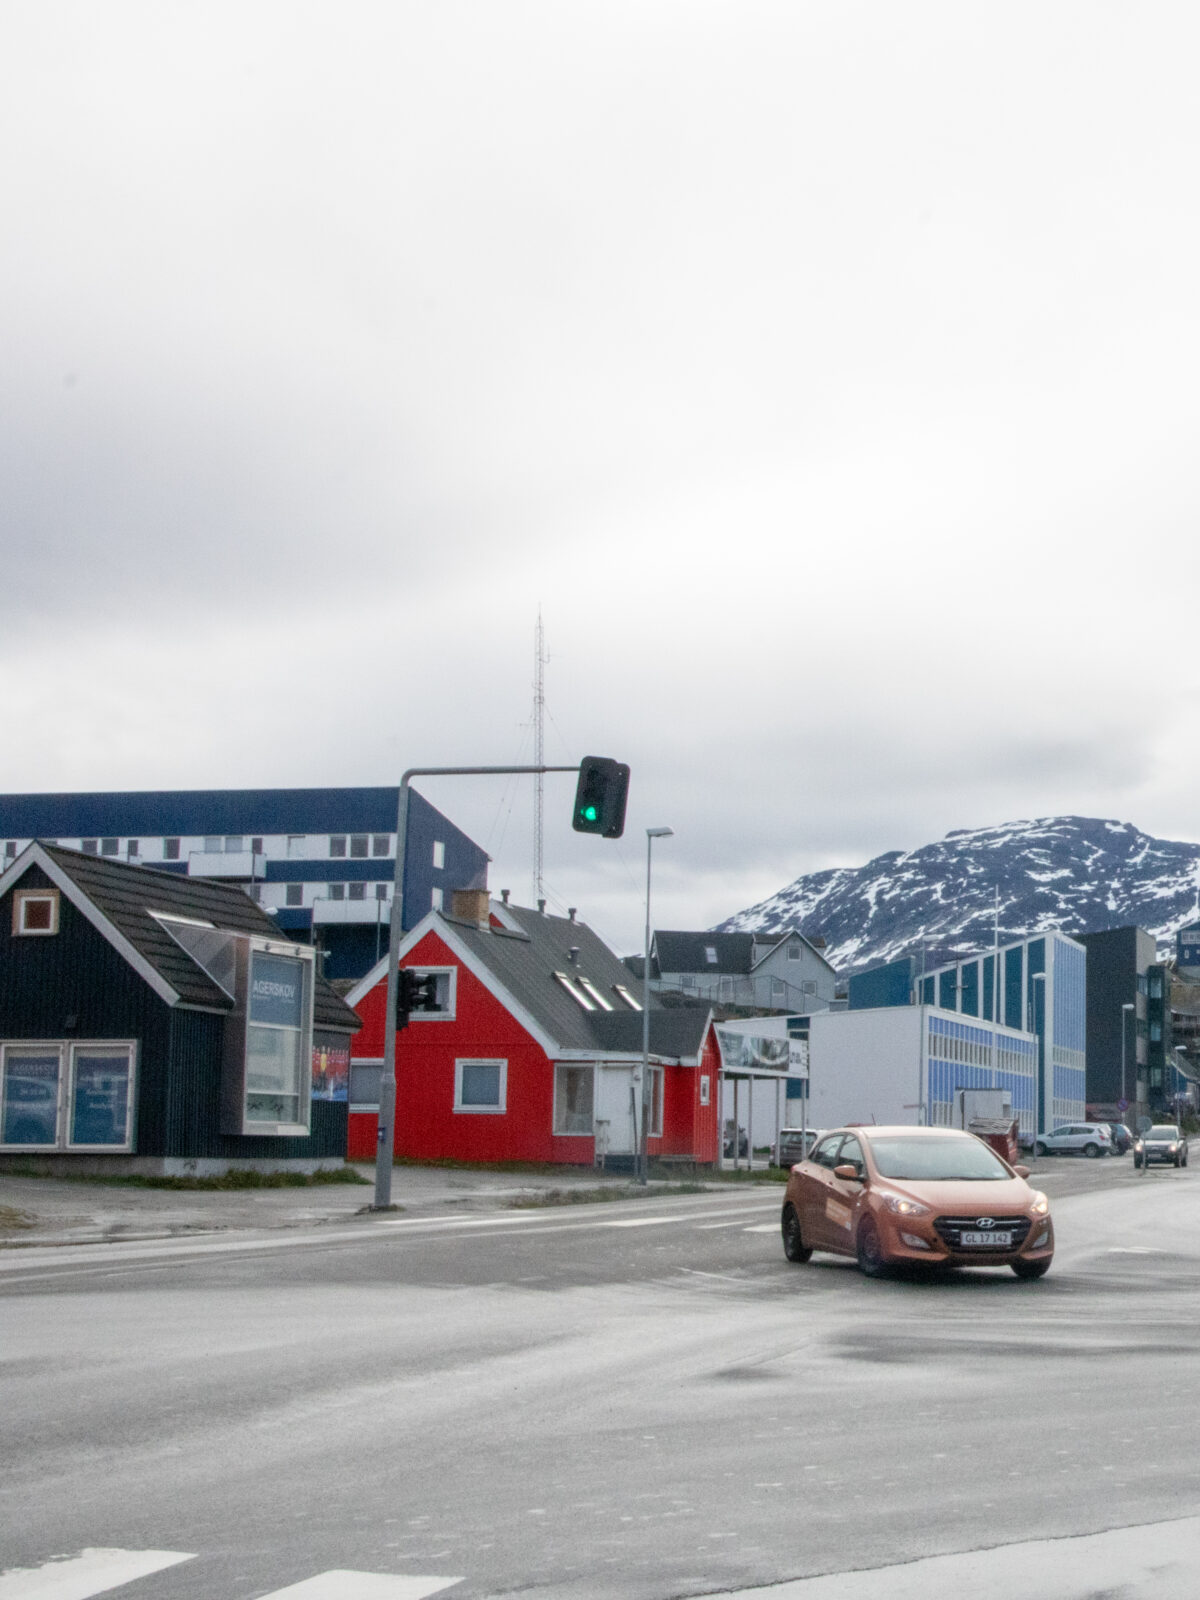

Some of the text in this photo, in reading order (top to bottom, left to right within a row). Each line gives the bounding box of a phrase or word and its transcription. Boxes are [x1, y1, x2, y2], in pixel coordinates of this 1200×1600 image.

[252, 979, 296, 999] AGERSKOV
[965, 1233, 1008, 1243] GL 17 142
